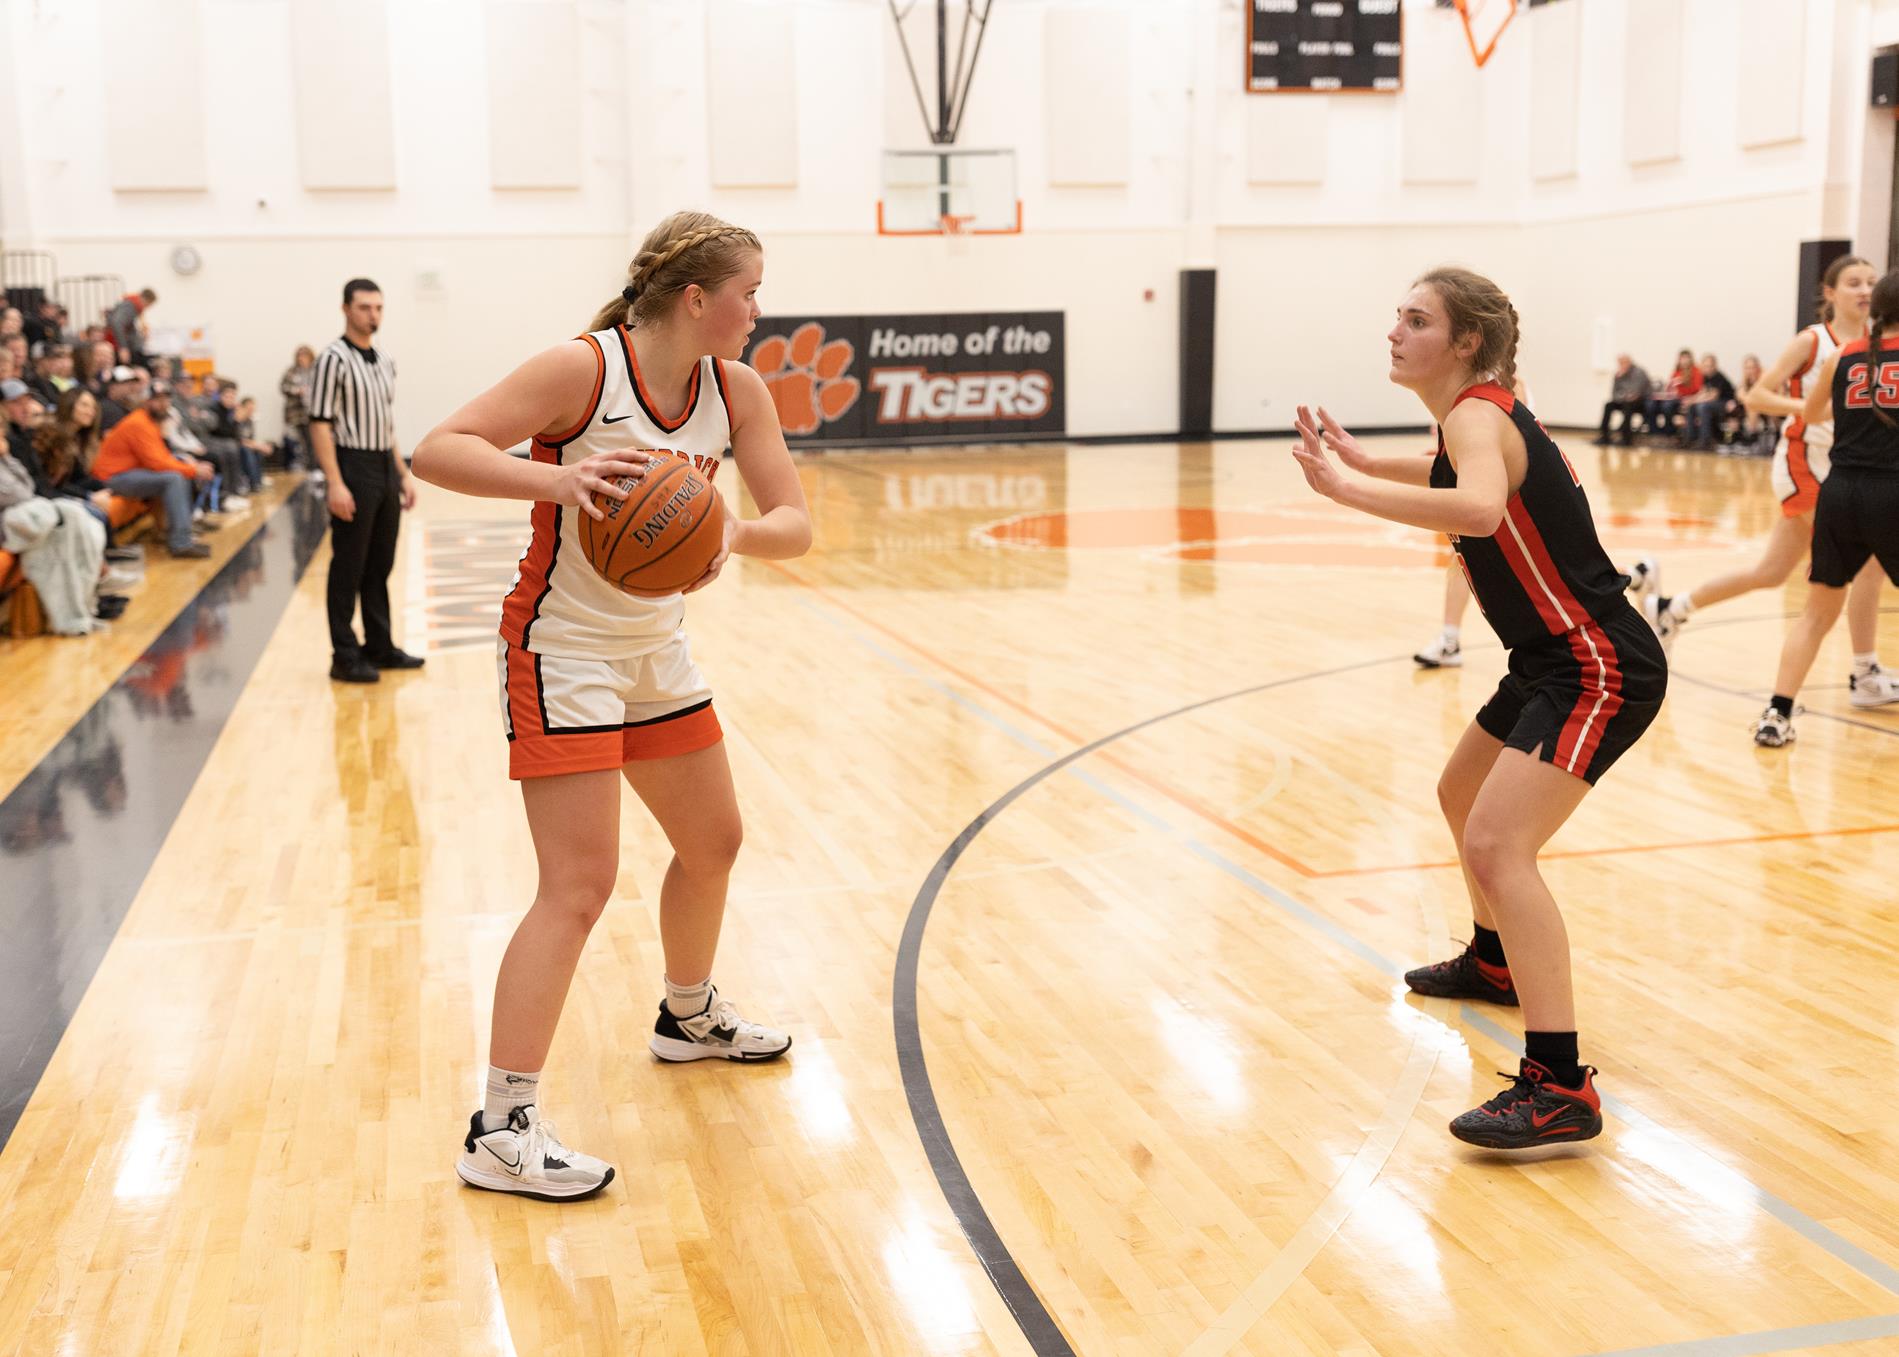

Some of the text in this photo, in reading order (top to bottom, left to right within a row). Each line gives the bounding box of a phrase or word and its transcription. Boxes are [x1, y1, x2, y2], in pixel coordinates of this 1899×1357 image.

[869, 325, 1051, 357] Home of the
[869, 367, 1052, 421] TIGERS
[1846, 362, 1899, 409] 25
[632, 471, 705, 549] SPALDING
